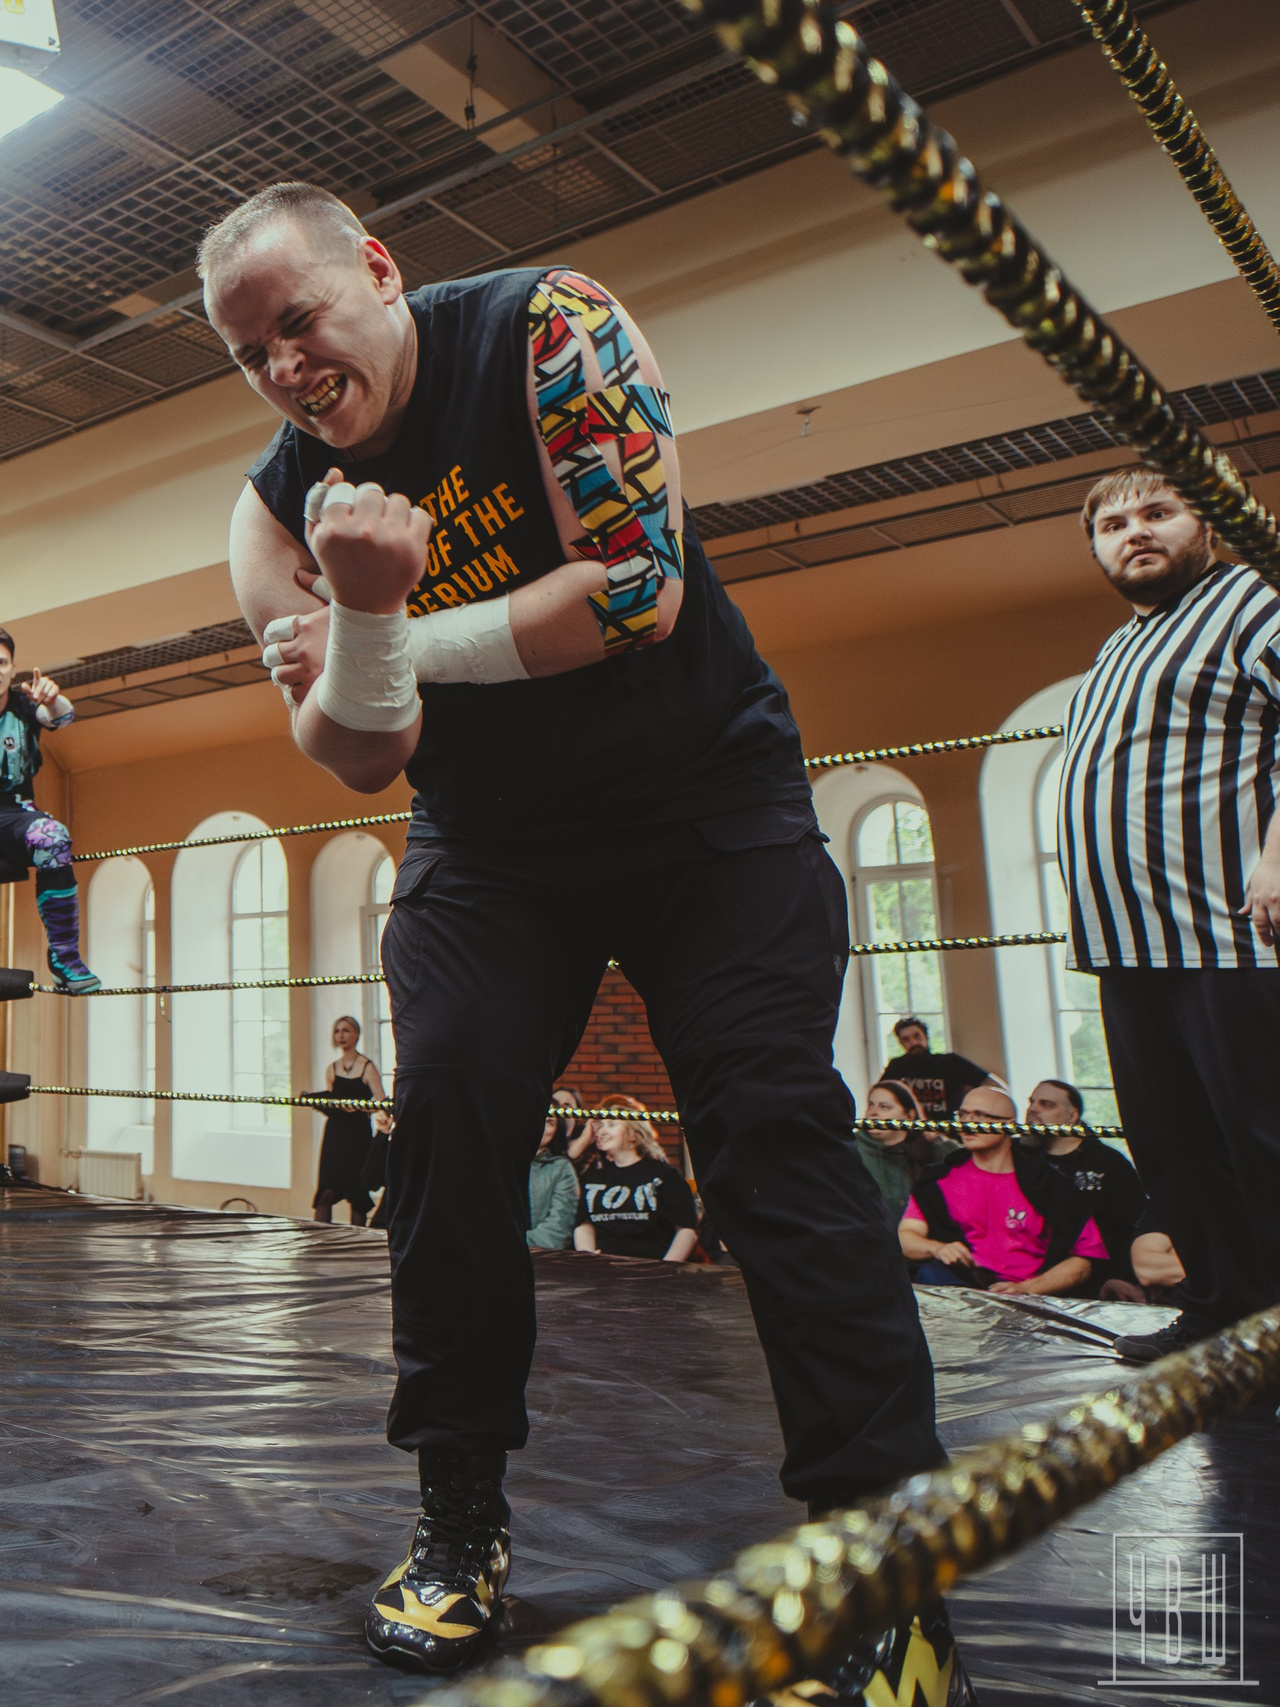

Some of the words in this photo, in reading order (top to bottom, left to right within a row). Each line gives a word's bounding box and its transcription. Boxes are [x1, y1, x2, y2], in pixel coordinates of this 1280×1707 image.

[420, 464, 470, 527] THE
[427, 528, 452, 577] OF
[454, 482, 525, 547] THE
